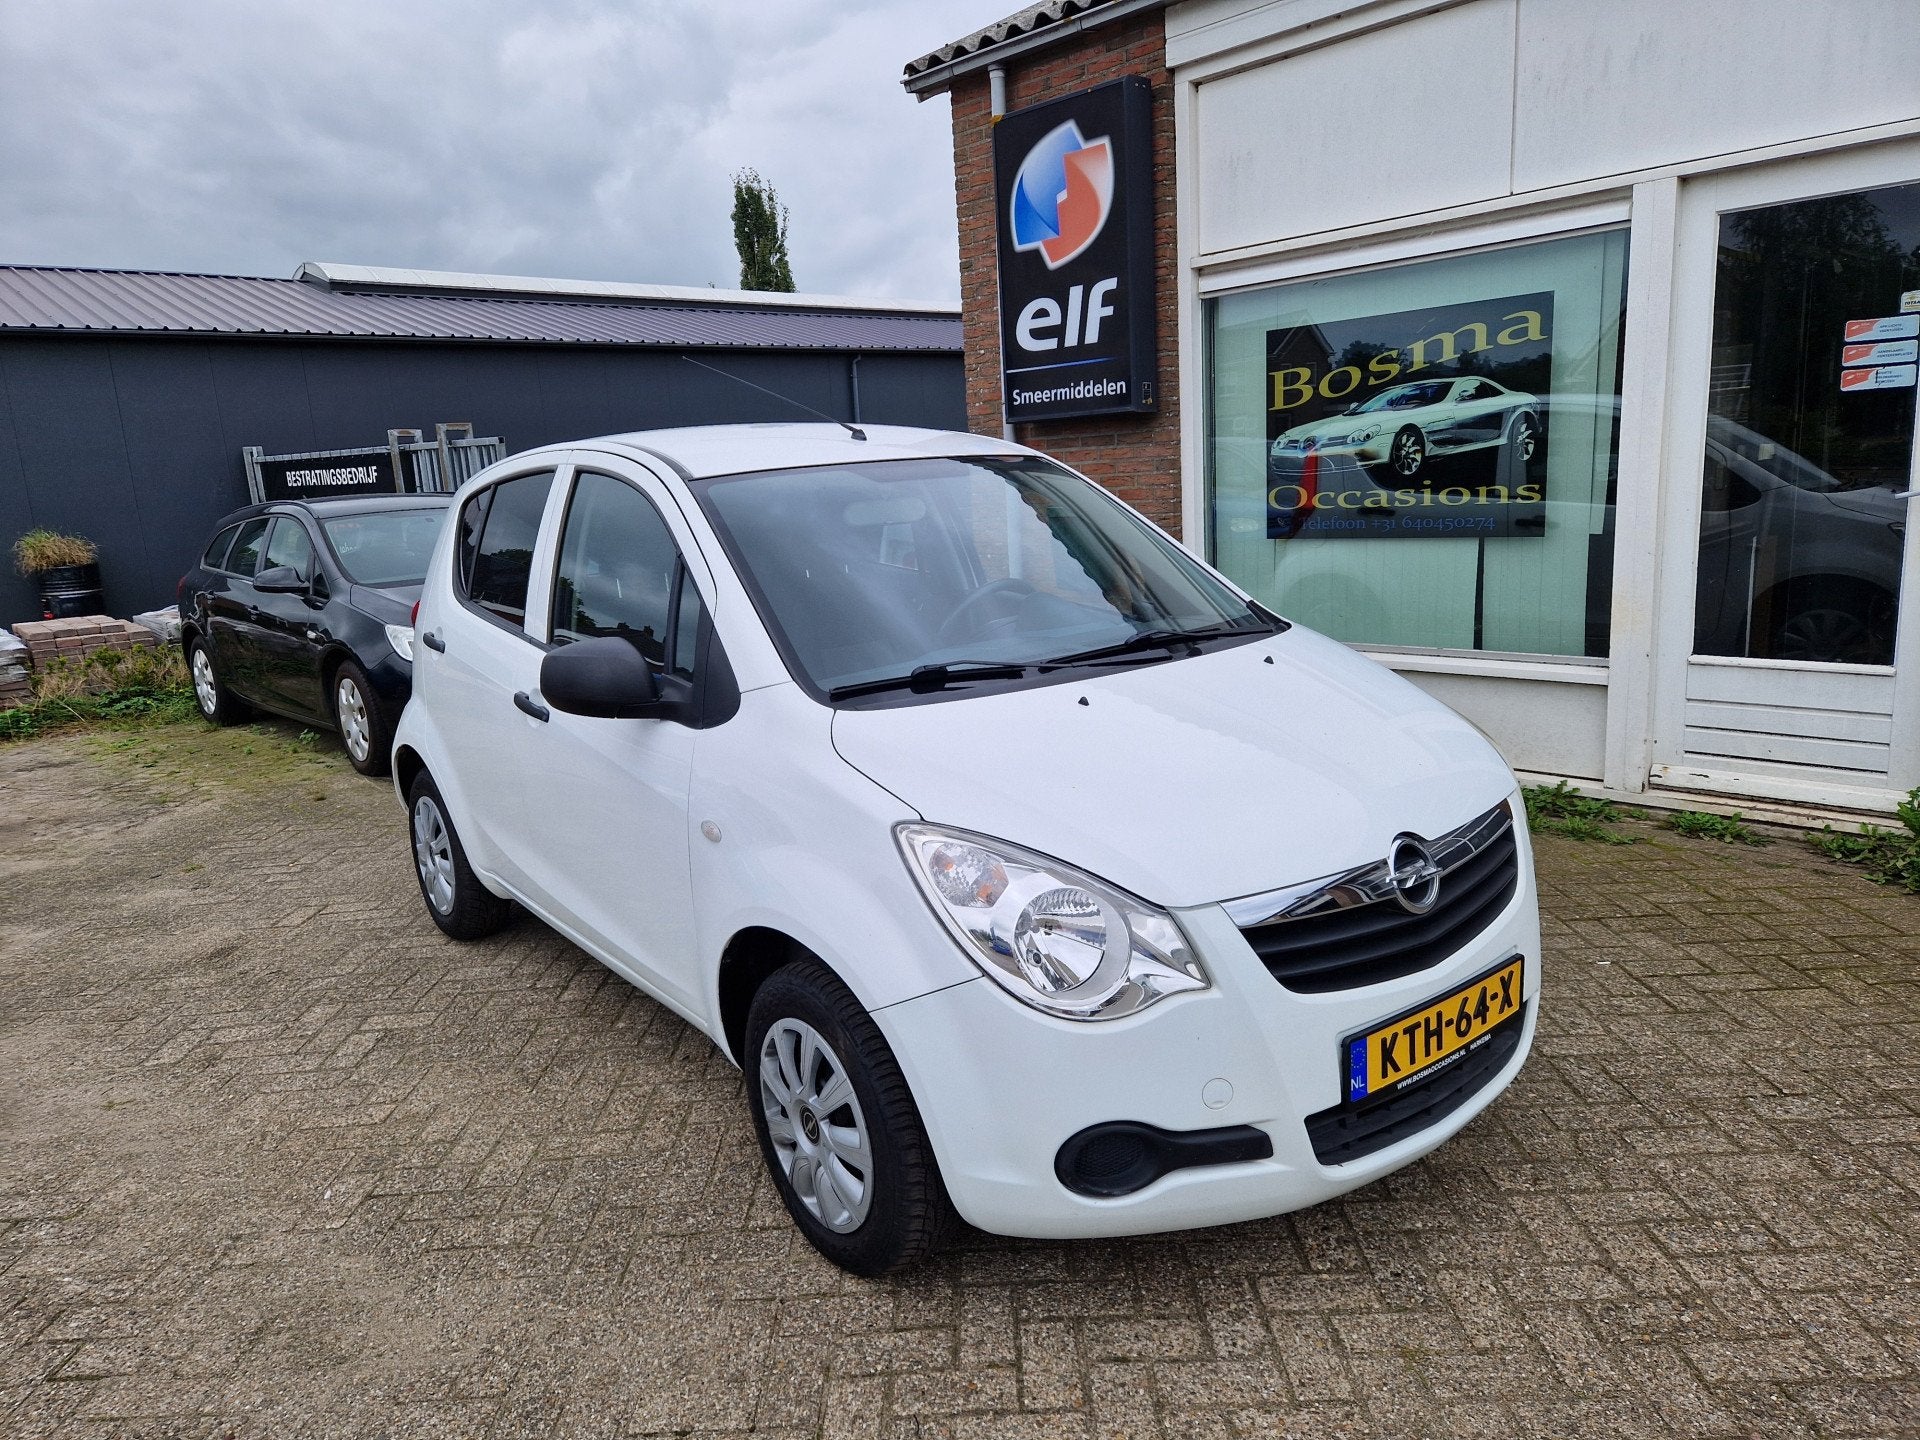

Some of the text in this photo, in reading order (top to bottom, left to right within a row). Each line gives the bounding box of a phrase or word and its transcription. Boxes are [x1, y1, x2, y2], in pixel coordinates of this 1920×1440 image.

[1015, 276, 1118, 352] elf
[1268, 309, 1549, 412] Bosma
[1012, 378, 1127, 406] Smeermiddelen
[285, 465, 379, 487] BESTRATINGSBEDRIJF
[1268, 479, 1543, 511] Occasions
[1299, 515, 1496, 532] Telefoon +31 640450274
[1379, 969, 1515, 1080] KTH-64-X
[1350, 1074, 1365, 1092] NL
[1396, 1048, 1467, 1090] WWW.BOSMAOCCASIONS.NL
